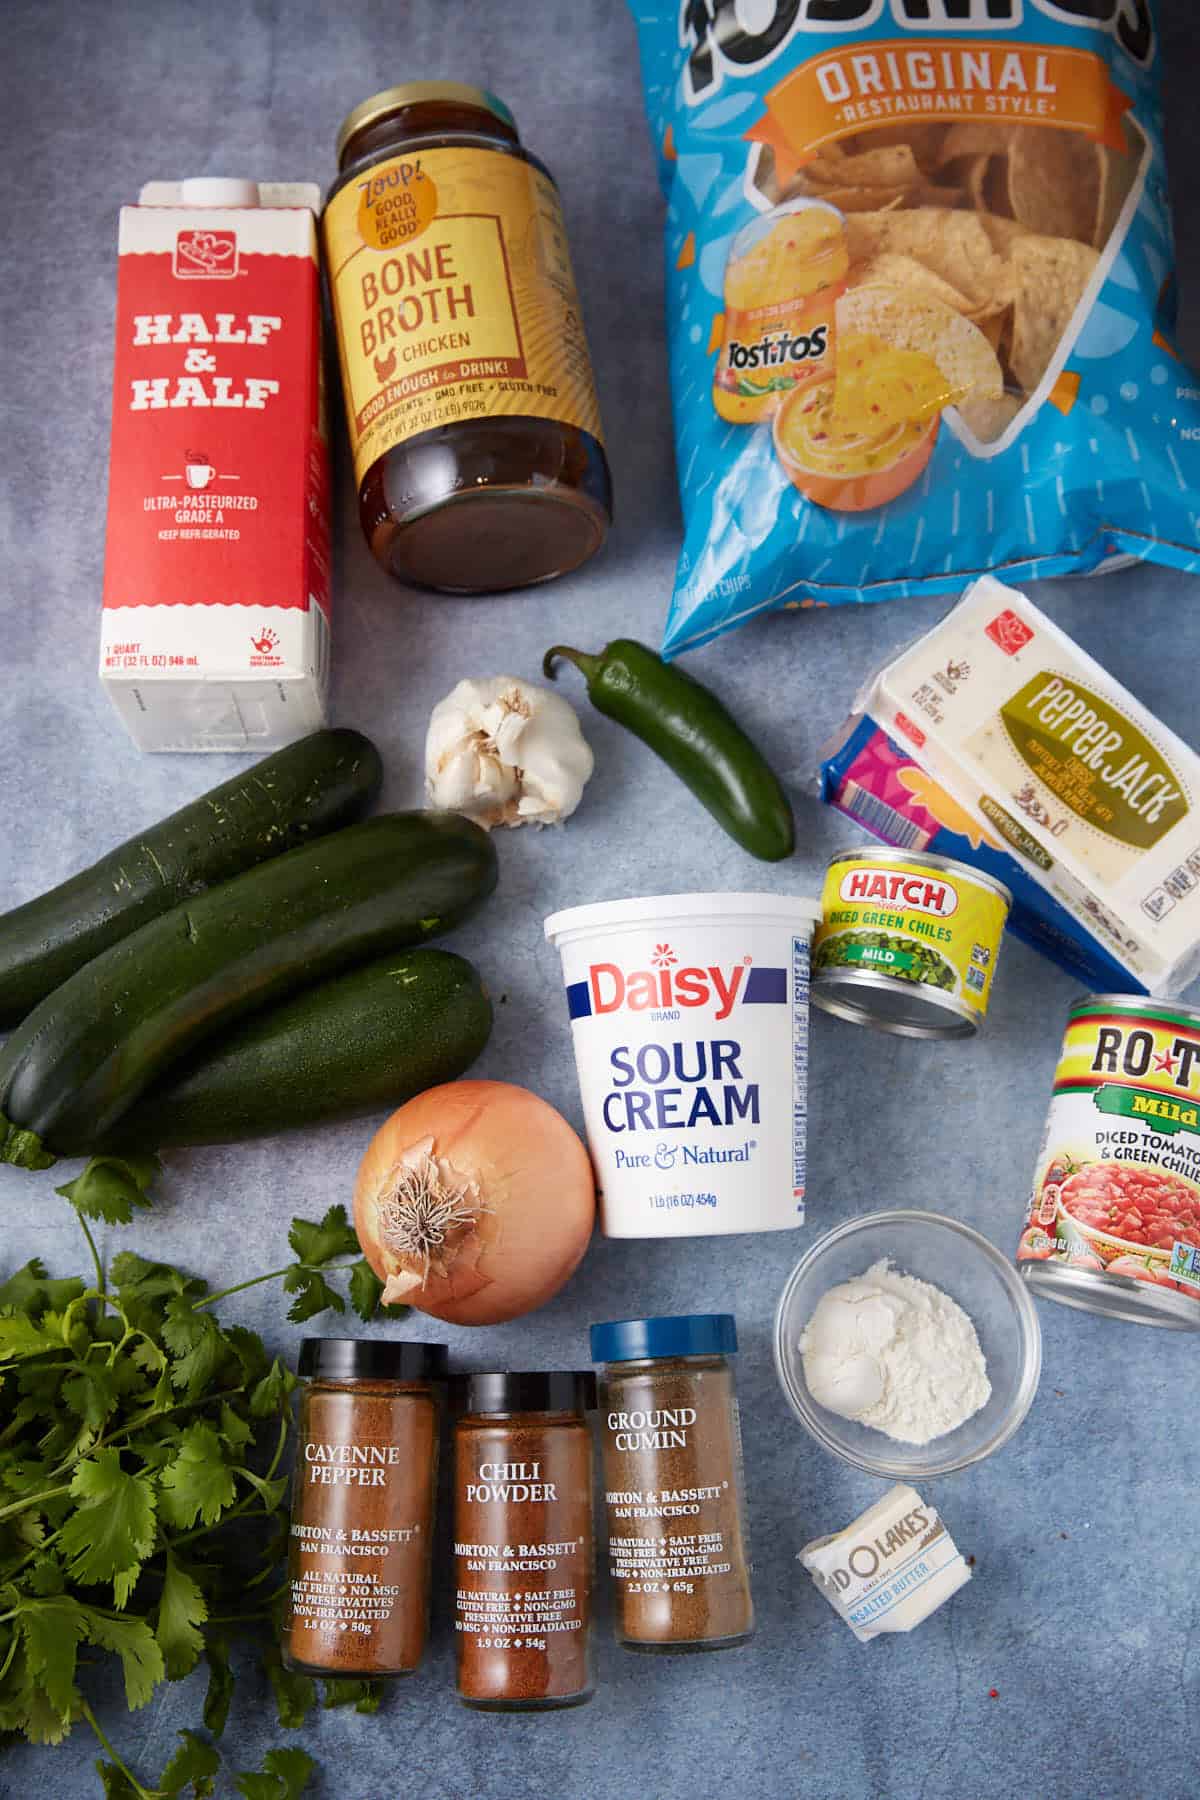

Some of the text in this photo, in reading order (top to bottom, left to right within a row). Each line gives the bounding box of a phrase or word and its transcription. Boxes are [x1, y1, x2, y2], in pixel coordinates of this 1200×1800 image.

[816, 52, 1056, 103] ORIGINAL
[842, 95, 1048, 121] RESTAURANT STYLE
[376, 206, 416, 232] REALLY
[381, 221, 416, 244] GOOD
[361, 244, 457, 311] BONE
[360, 284, 474, 357] BROTH
[133, 314, 282, 346] HALF
[402, 332, 471, 362] CHICKEN
[184, 348, 216, 373] &
[130, 377, 280, 410] HALF
[362, 395, 385, 424] GOOD
[386, 372, 438, 406] ENOUGH
[460, 361, 509, 377] DRINK!
[435, 388, 455, 400] GMO
[459, 383, 484, 395] FREE
[499, 382, 533, 393] GLUTEN
[536, 385, 558, 398] FREE
[143, 496, 258, 511] ULTRA-PASTEURIZED
[175, 510, 224, 524] GRADE A
[158, 529, 240, 540] KEEP REFRIGERATED
[113, 643, 141, 655] QUART
[105, 655, 121, 666] NET
[1102, 753, 1180, 825] JACK
[850, 874, 946, 911] HATCH
[830, 911, 952, 942] DICED GREEN CHILES
[862, 948, 895, 962] MILD
[589, 962, 744, 1020] Daisy
[610, 1040, 743, 1087] SOUR
[603, 1084, 760, 1133] CREAM
[1131, 1094, 1198, 1127] Mild
[1096, 1131, 1138, 1144] DICED
[615, 1142, 749, 1169] Pure & Natural
[1101, 1147, 1110, 1159] &
[1114, 1148, 1160, 1164] GREEN
[696, 1193, 717, 1207] 454g
[608, 1408, 697, 1430] GROUND
[616, 1431, 687, 1451] CUMIN
[305, 1443, 400, 1465] CAYENNE
[310, 1466, 386, 1487] PEPPER
[479, 1463, 540, 1481] CHILI
[466, 1484, 558, 1503] POWDER
[646, 1491, 658, 1503] &
[661, 1487, 721, 1502] BASSETT
[616, 1505, 700, 1518] SAN FRANCISCO
[335, 1529, 347, 1540] &
[351, 1529, 412, 1541] BASSETT
[617, 1538, 657, 1547] NATURAL
[669, 1536, 697, 1546] SALT
[698, 1533, 722, 1544] FREE
[848, 1544, 879, 1578] O
[874, 1507, 929, 1559] LAKES
[300, 1542, 389, 1556] SAN FRANCISCO
[455, 1542, 577, 1557] MORTON & BASSETT
[634, 1548, 657, 1557] FREE
[669, 1544, 723, 1556] NON-GMO
[467, 1559, 557, 1571] SAN FRANCISCO
[617, 1555, 709, 1568] PRESERVATIVE FREE
[303, 1571, 380, 1584] ALL NATURAL
[640, 1563, 730, 1578] NON-IRRADIATED
[892, 1562, 929, 1596] BUTTER
[291, 1580, 400, 1596] SALT FREE NO MSG
[457, 1589, 576, 1601] ALL NATURAL SALT FREE
[643, 1583, 659, 1592] OZ
[673, 1582, 694, 1594] 65g
[292, 1592, 394, 1607] NO PRESERVATIVES
[457, 1600, 576, 1612] GLUTEN FREE NON-GMO
[293, 1604, 390, 1620] NON-IRRADIATED
[464, 1612, 561, 1622] PRESERVATIVE FREE
[320, 1620, 336, 1630] OZ
[351, 1622, 371, 1635] 50g
[463, 1622, 480, 1632] MSG
[491, 1619, 581, 1634] NON-IRRADIATED
[477, 1638, 546, 1650] 1.9 OZ 54g
